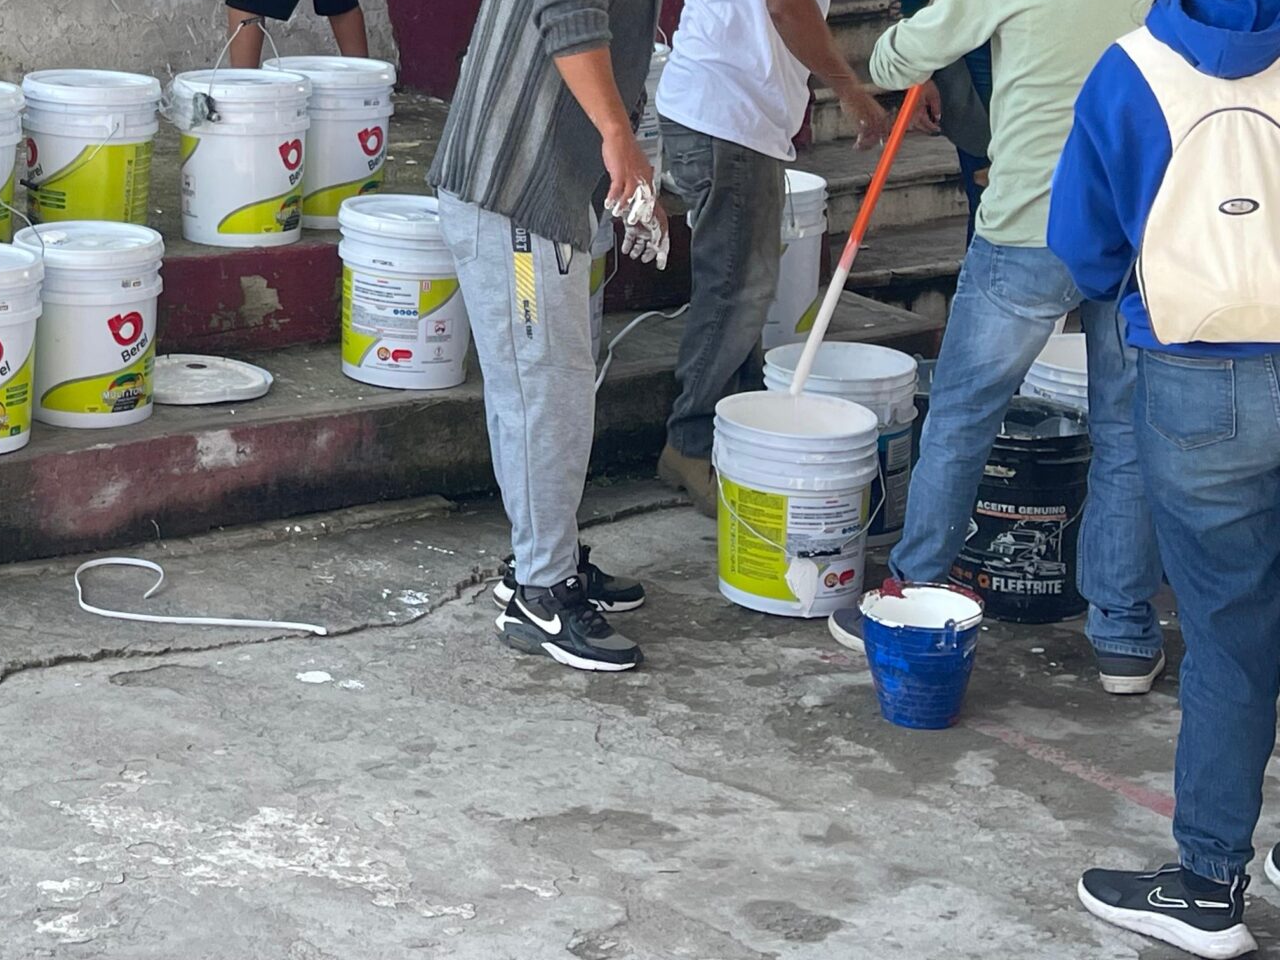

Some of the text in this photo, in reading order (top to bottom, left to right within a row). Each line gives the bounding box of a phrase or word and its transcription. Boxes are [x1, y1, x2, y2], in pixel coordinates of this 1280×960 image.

[121, 332, 148, 363] Berel
[976, 500, 1066, 515] ACEITE GENUINO
[992, 577, 1063, 594] FLEETRITE
